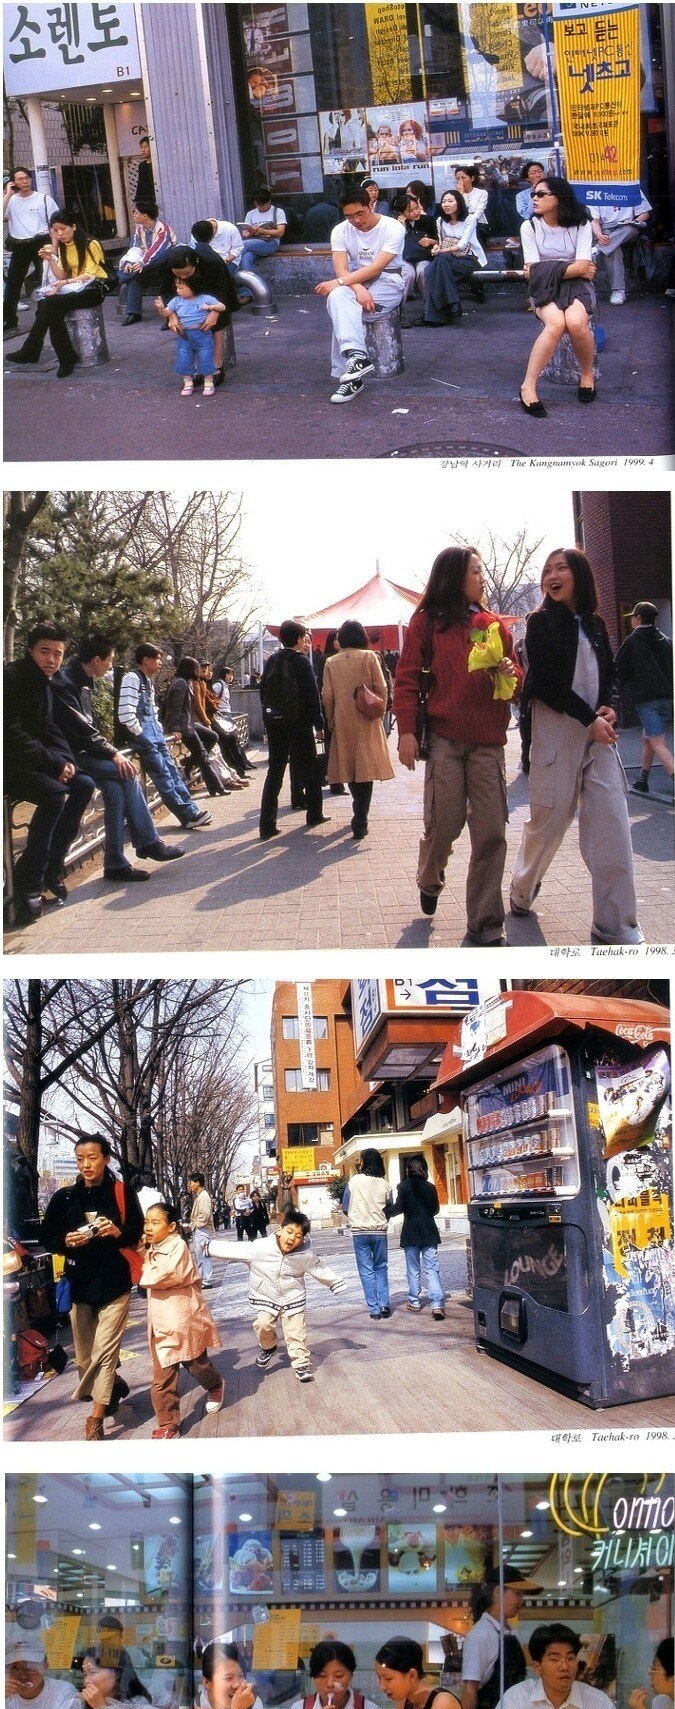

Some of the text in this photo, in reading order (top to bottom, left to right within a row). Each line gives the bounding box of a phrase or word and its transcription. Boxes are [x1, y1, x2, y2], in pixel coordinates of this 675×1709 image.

[9, 3, 129, 65] 소렌토
[564, 19, 618, 42] 보고 듣는
[116, 66, 130, 77] B1
[372, 165, 389, 173] run
[391, 164, 410, 172] lola
[586, 191, 628, 201] SK Telecom
[503, 1246, 564, 1285] LOUNGE
